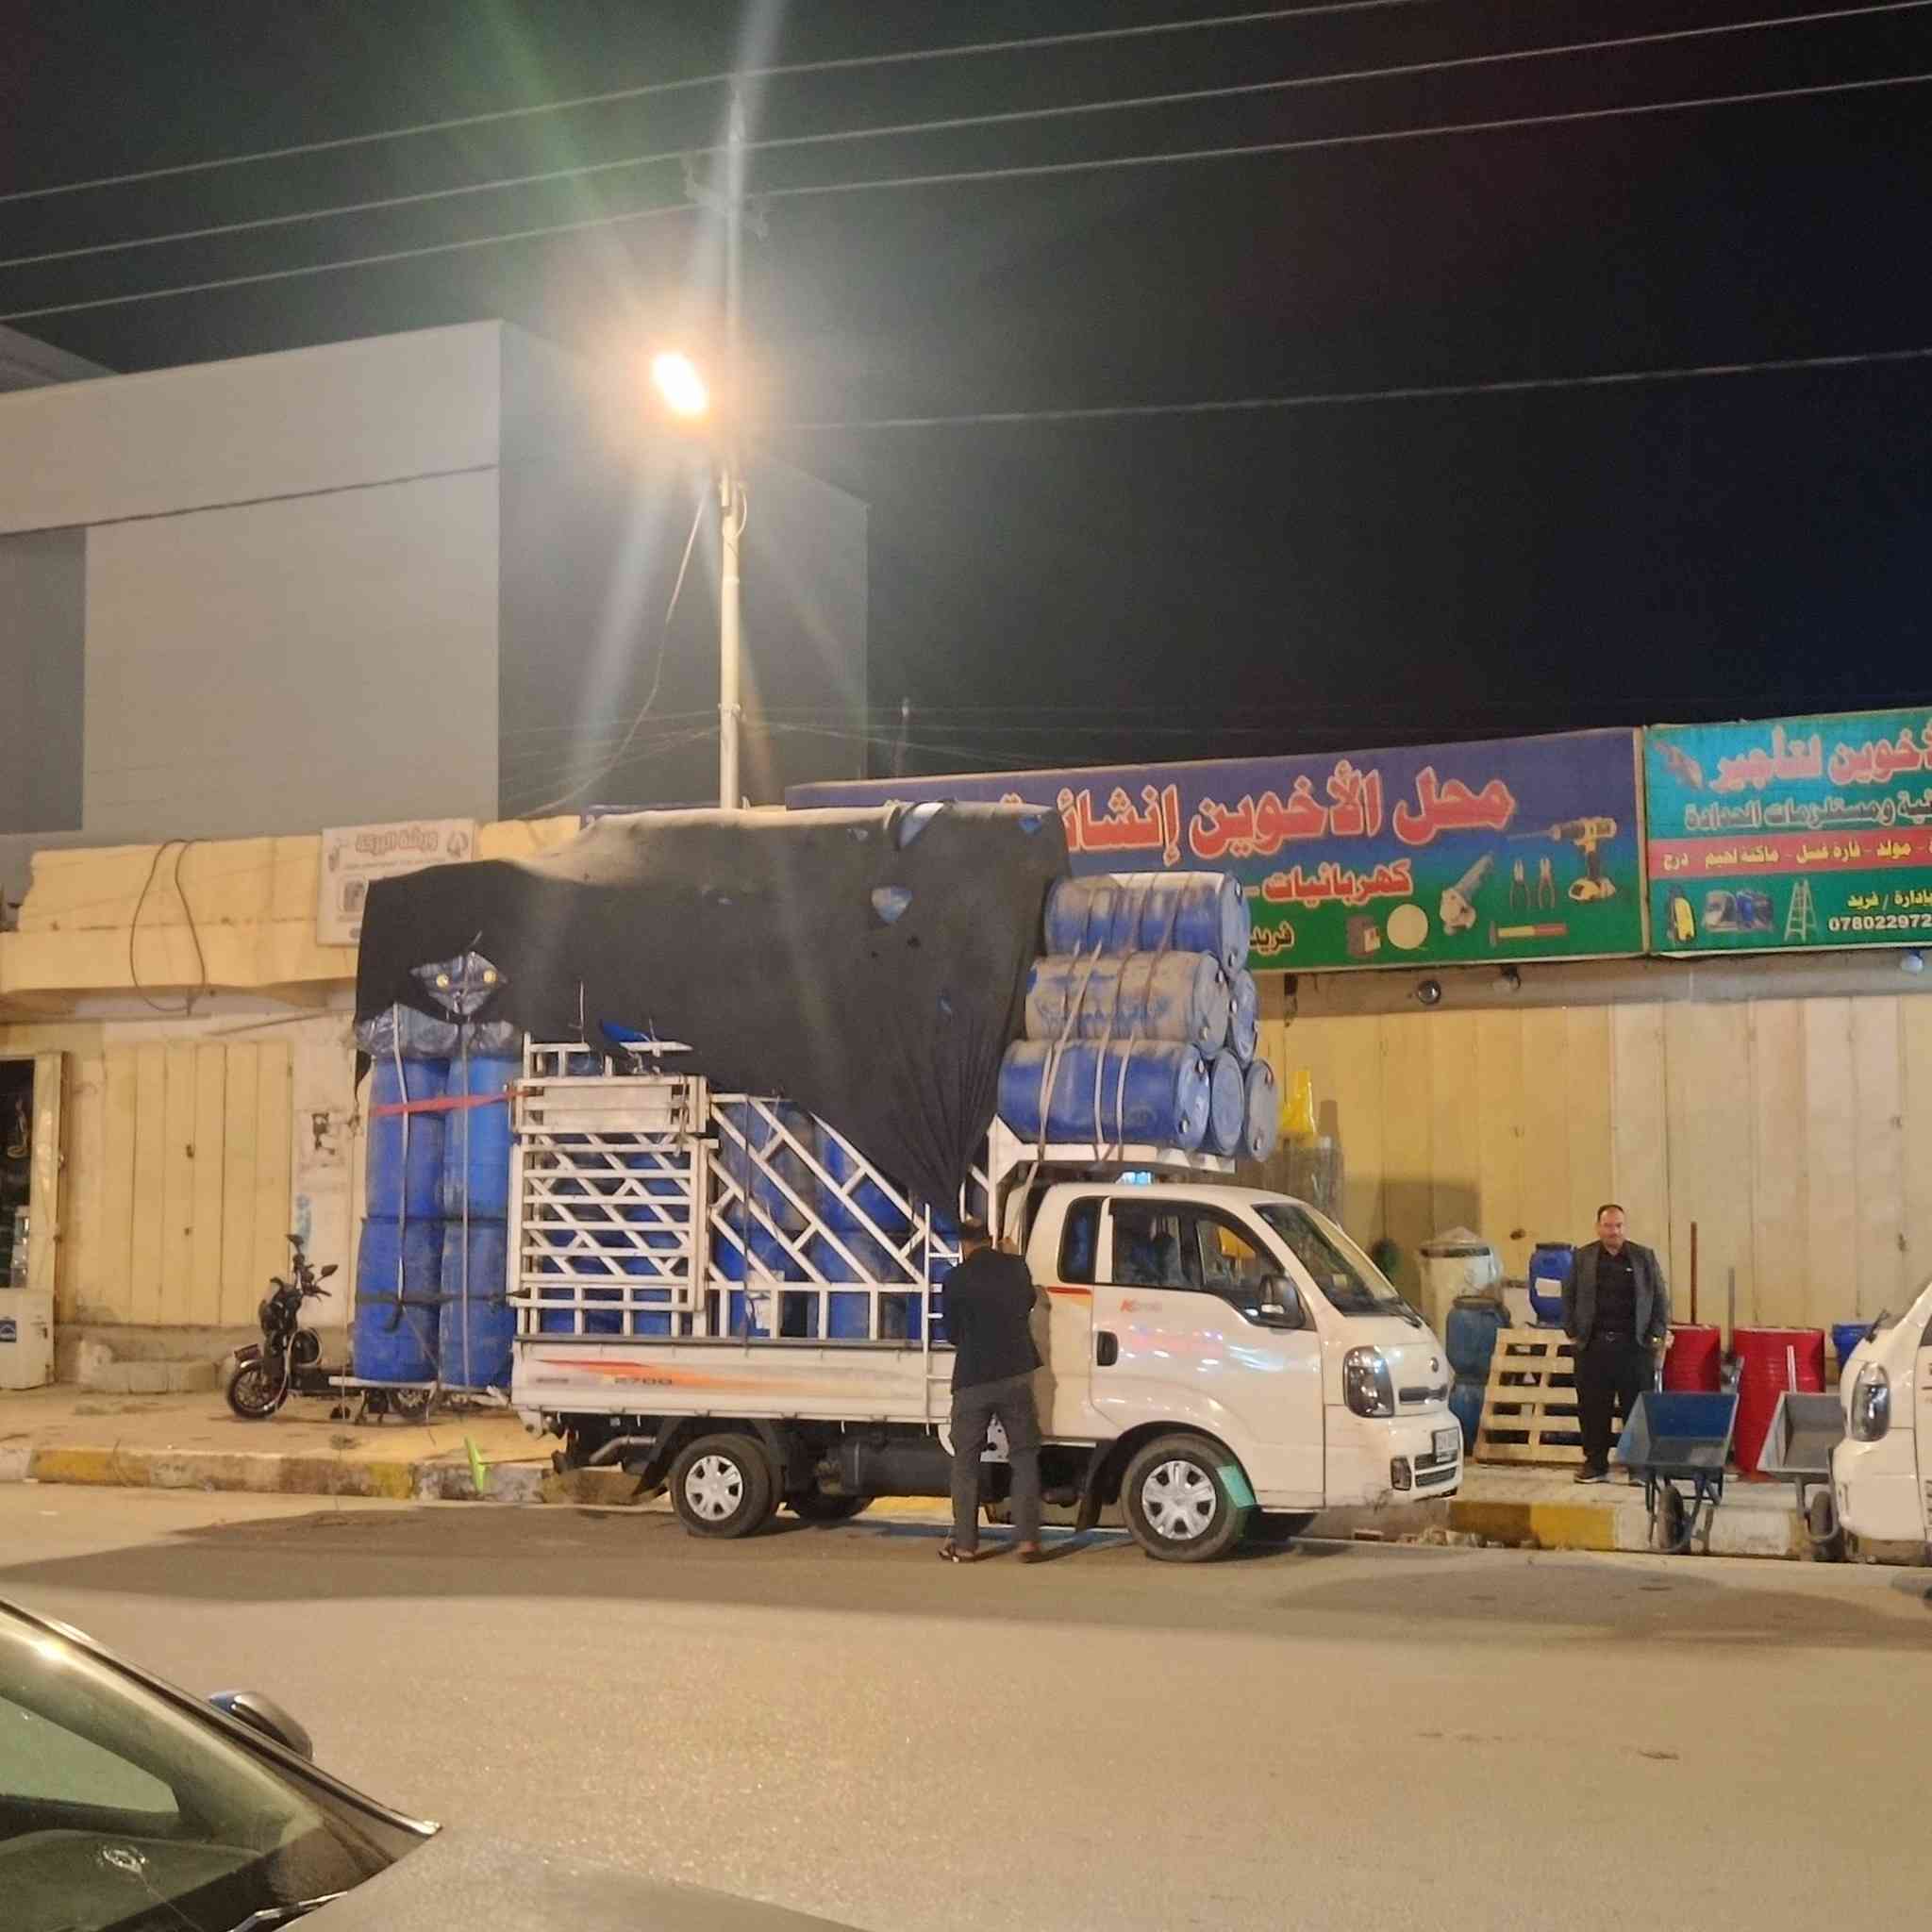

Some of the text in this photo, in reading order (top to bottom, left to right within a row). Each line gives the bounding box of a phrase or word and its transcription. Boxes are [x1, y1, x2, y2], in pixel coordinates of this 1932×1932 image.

[1190, 759, 1383, 858] الأخوين
[1393, 766, 1516, 845] محل
[1877, 839, 1912, 859] مولد
[1262, 858, 1413, 908] كهربائيات
[1847, 891, 1879, 910] فريد
[1248, 920, 1295, 956] فريد
